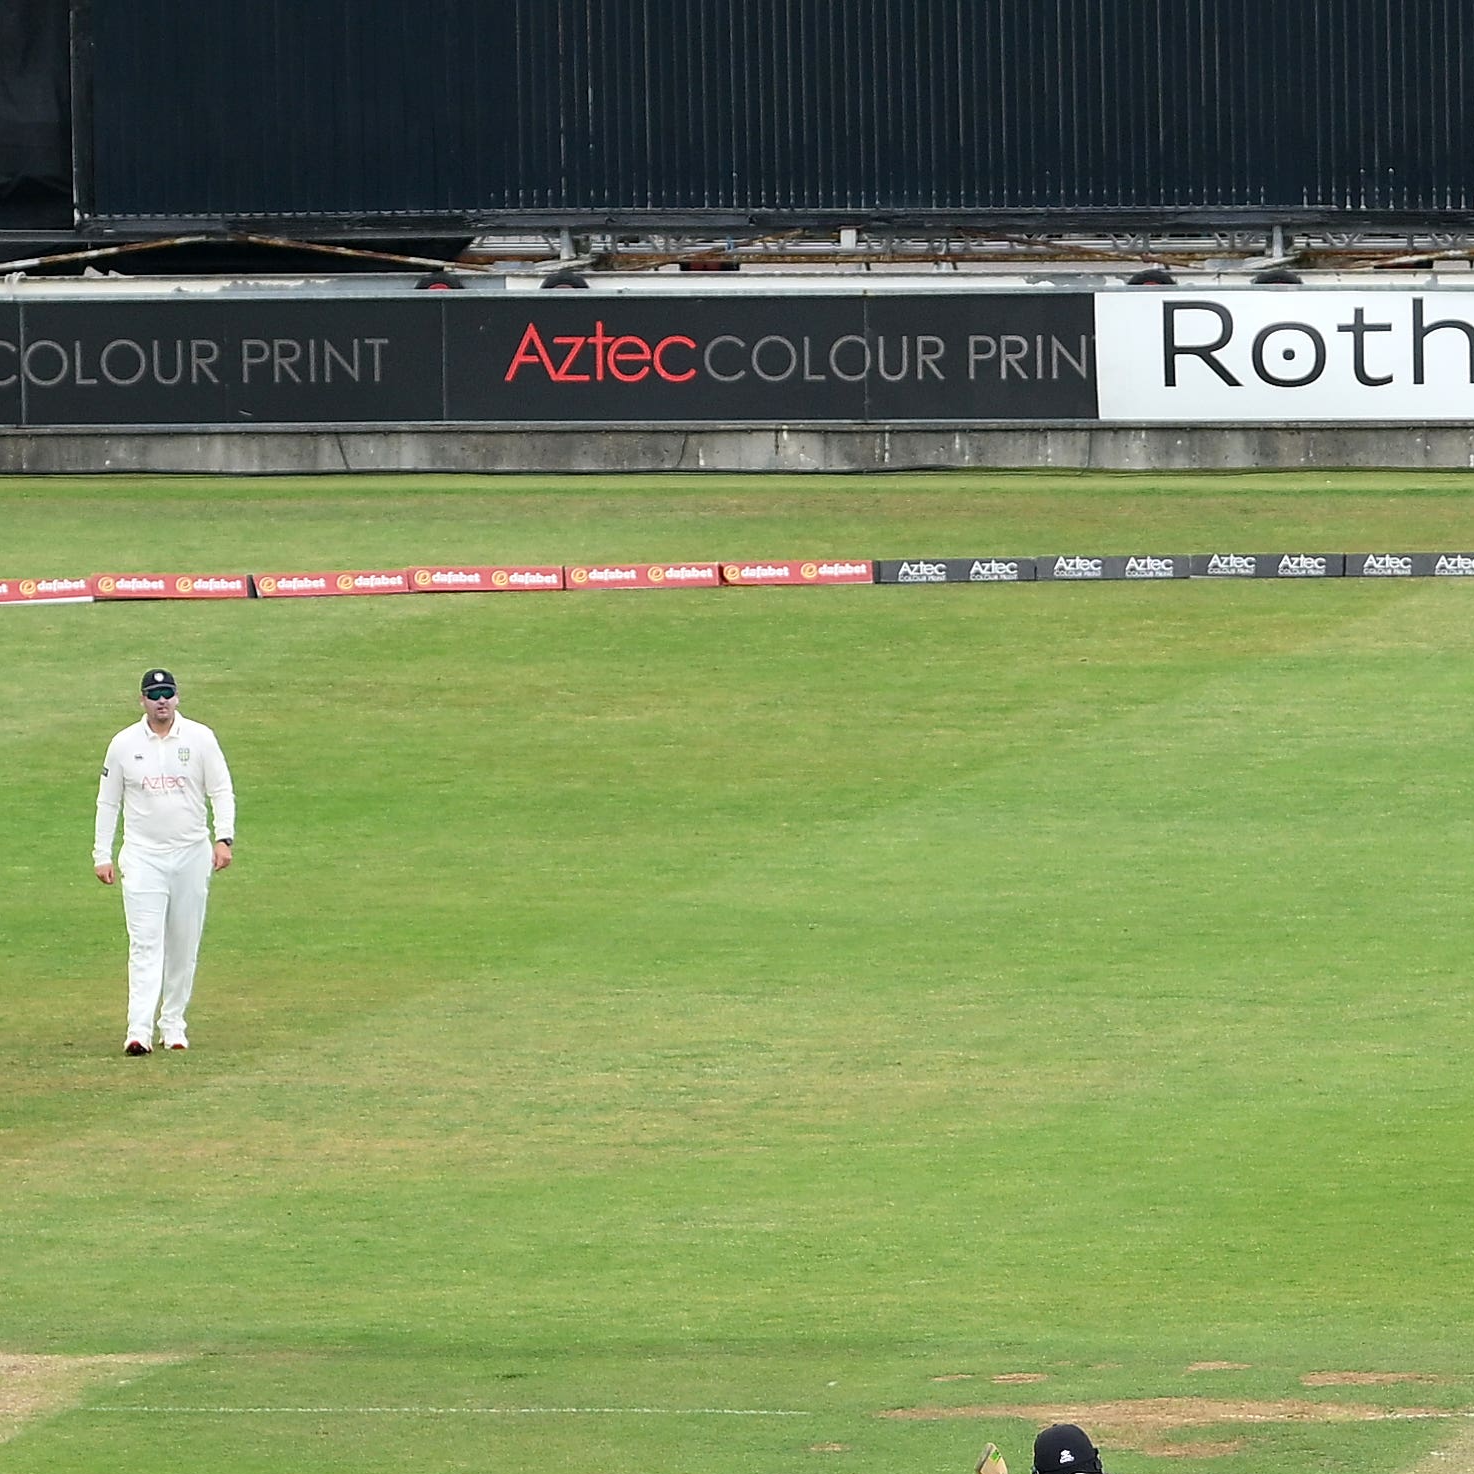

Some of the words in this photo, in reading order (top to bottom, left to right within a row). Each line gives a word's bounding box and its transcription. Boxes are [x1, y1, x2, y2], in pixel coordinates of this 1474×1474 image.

[241, 338, 389, 384] PRINT
[968, 334, 1095, 380] PRIN
[897, 560, 946, 574] Aztec
[969, 559, 1018, 573] Aztec
[1053, 555, 1102, 569] Aztec
[1124, 555, 1173, 569] Aztec
[1207, 553, 1256, 567] Aztec
[1277, 554, 1326, 568] Aztec
[1363, 553, 1412, 567] Aztec
[587, 568, 636, 582] dafabet
[664, 567, 713, 581] dafabet
[740, 565, 789, 579] dafabet
[817, 563, 866, 577] dafabet
[115, 578, 164, 592] dafabet
[192, 578, 241, 592] dafabet
[276, 577, 325, 591] dafabet
[353, 574, 402, 588] dafabet
[431, 571, 480, 585] dafabet
[508, 572, 557, 586] dafabet
[36, 579, 85, 593] dafabet
